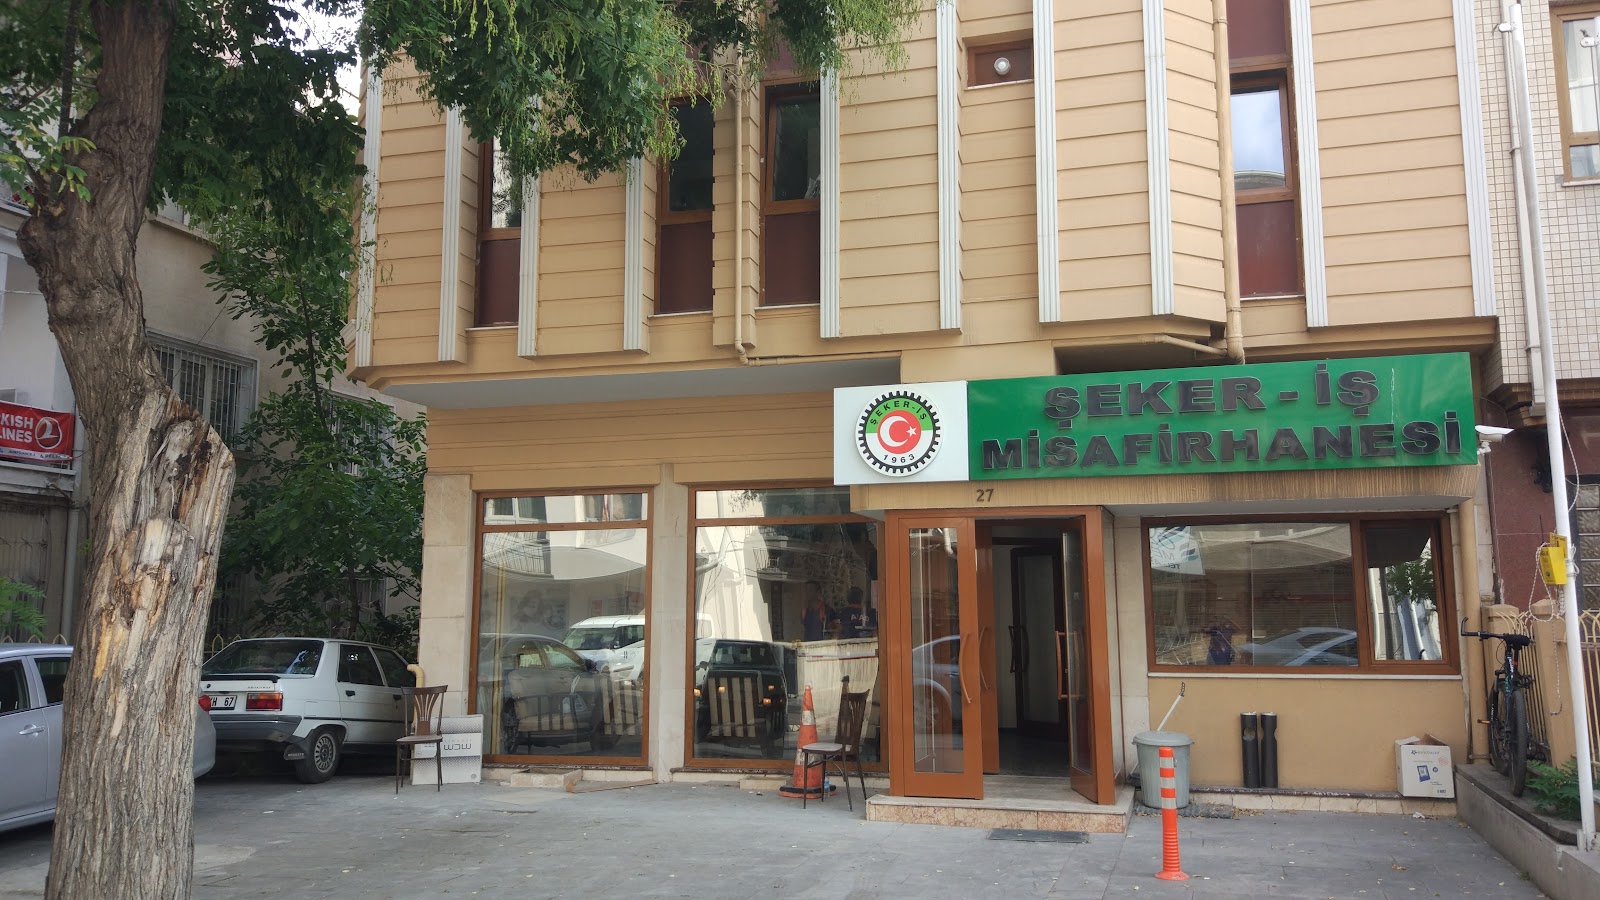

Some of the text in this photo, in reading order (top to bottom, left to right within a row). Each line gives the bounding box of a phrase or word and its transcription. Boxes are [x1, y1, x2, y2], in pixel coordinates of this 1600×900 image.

[1044, 376, 1266, 430] ŞEKER
[1315, 363, 1379, 416] İŞ
[982, 411, 1461, 470] MİSAFİRHANESİ
[883, 454, 915, 463] 1963
[976, 488, 994, 502] 27
[224, 696, 235, 707] 67
